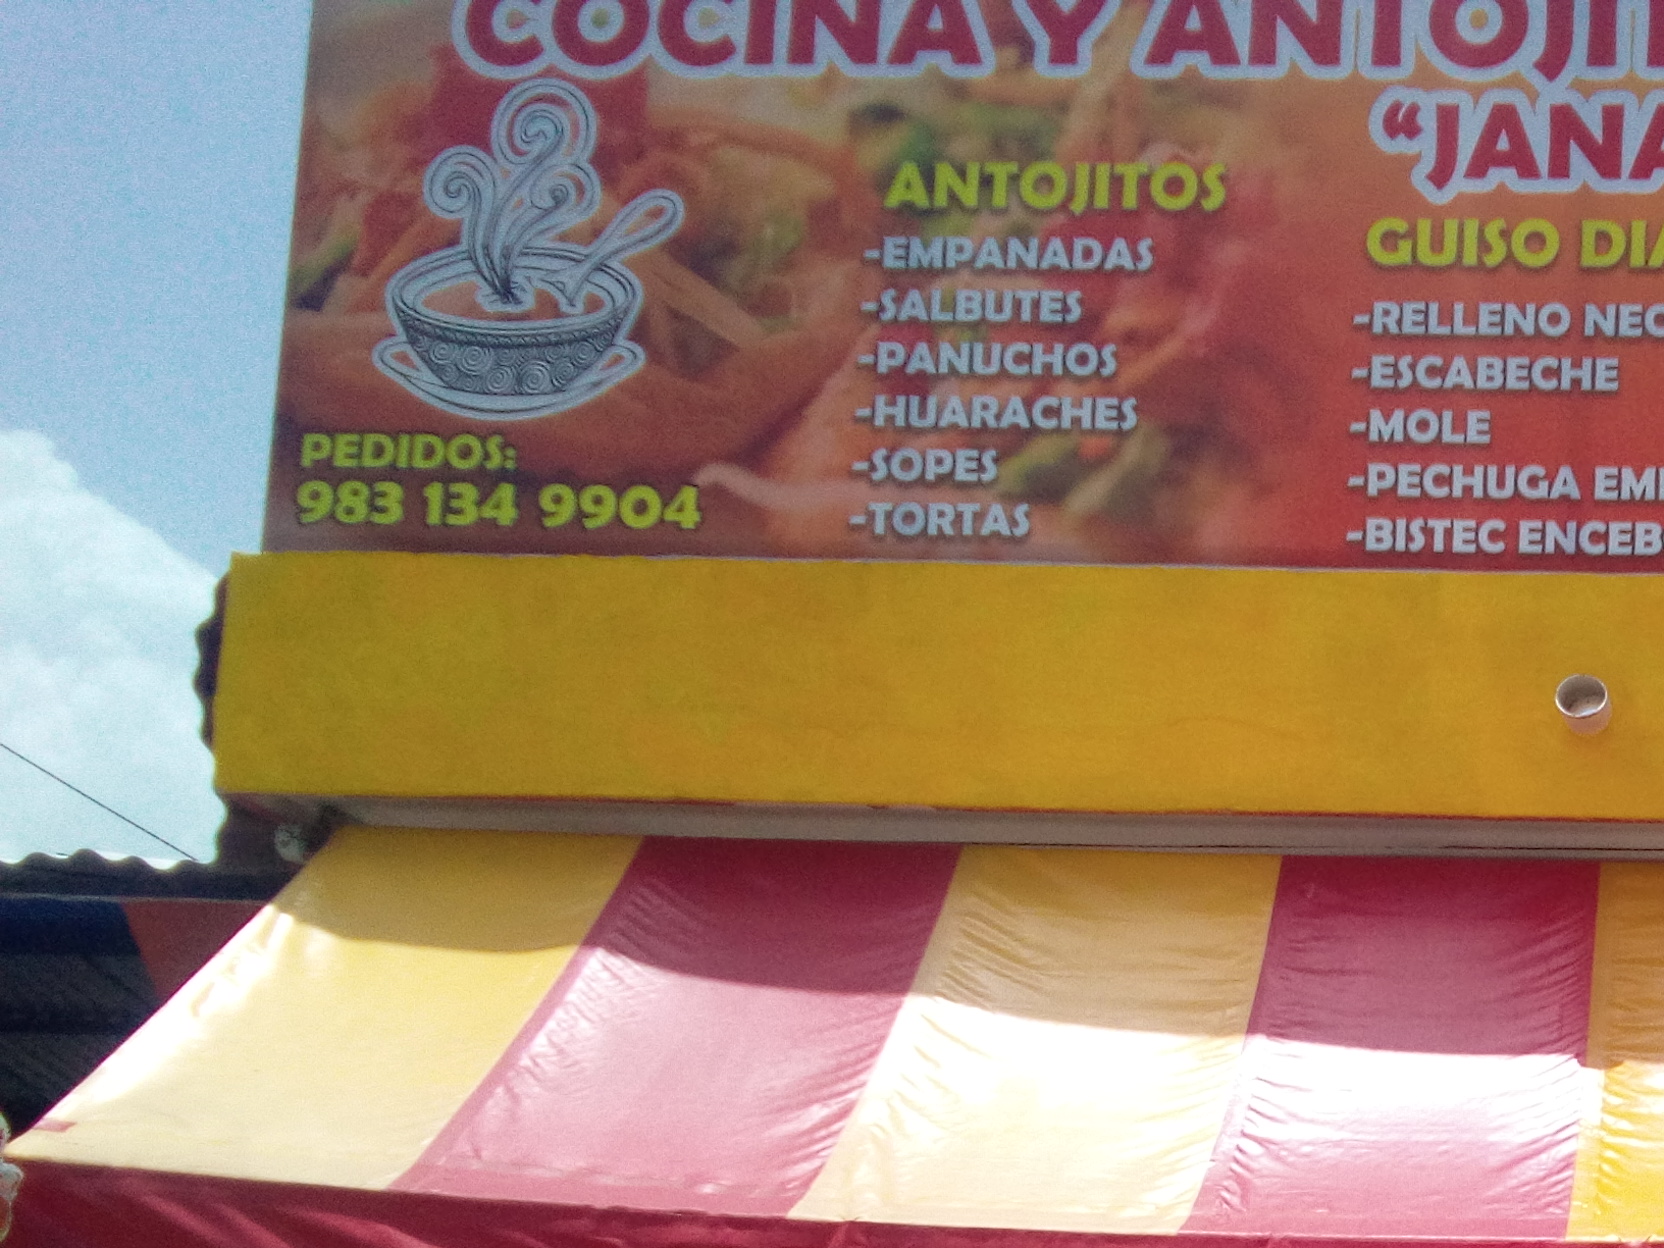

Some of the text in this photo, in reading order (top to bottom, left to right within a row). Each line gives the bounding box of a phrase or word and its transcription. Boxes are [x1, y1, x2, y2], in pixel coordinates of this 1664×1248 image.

[461, 0, 988, 71] COCINA
[1019, 0, 1106, 69] Y
[882, 161, 1228, 216] ANTOJITOS
[863, 236, 1155, 272] -EMPANADAS
[1366, 217, 1561, 268] GUISO
[860, 289, 1083, 324] -SALBUTES
[1353, 301, 1571, 339] -RELLENO
[858, 341, 1119, 377] -PANUCHOS
[1351, 355, 1620, 391] -ESCABECHE
[854, 394, 1139, 431] -HUARACHES
[1349, 409, 1492, 445] -MOLE
[300, 432, 518, 472] PEDIDOS:
[851, 448, 999, 484] -SOPES
[1346, 463, 1581, 501] -PECHUGA
[296, 479, 702, 531] 983 134 9904
[849, 501, 1031, 538] -TORTAS
[1346, 517, 1506, 554] -BISTEC
